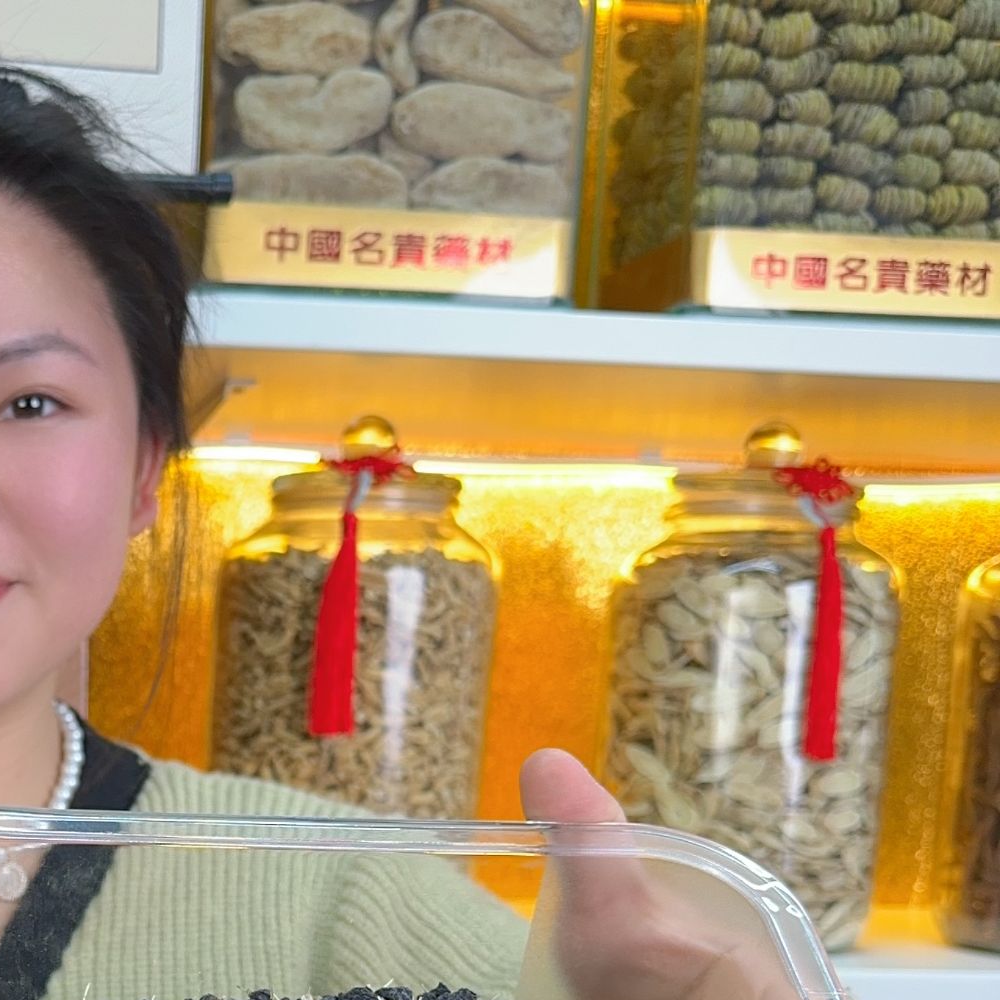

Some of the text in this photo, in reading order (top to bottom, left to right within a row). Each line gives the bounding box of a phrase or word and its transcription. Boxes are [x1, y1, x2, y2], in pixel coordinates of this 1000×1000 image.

[751, 253, 992, 296] 中國名貴藥材
